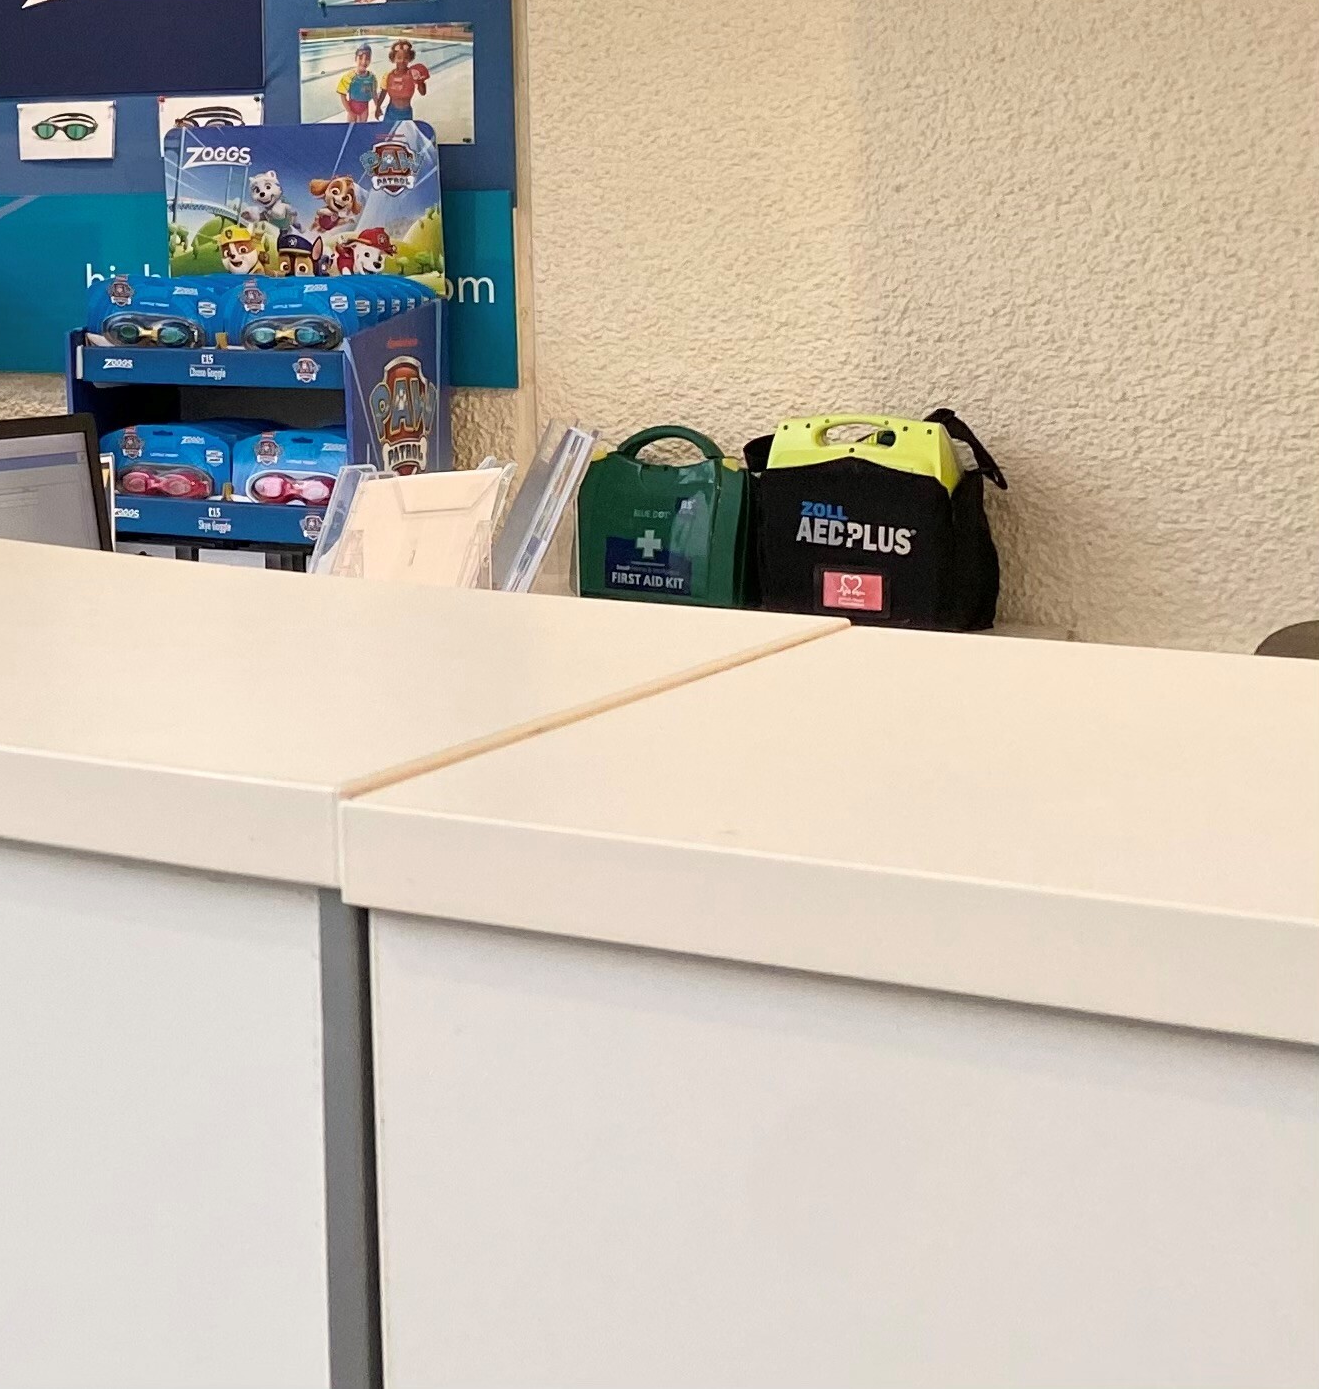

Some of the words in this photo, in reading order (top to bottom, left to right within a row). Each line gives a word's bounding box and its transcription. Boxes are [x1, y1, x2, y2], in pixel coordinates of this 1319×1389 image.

[183, 146, 252, 168] ZOGGS
[377, 177, 411, 185] PATROL
[103, 358, 133, 369] ZOGGS
[201, 354, 214, 364] £15
[369, 377, 437, 443] PAW
[388, 443, 424, 466] PATROL
[208, 507, 221, 518] £15
[801, 501, 849, 521] ZOLL
[611, 571, 641, 585] FIRST
[643, 574, 663, 587] AID
[665, 577, 684, 589] KIT
